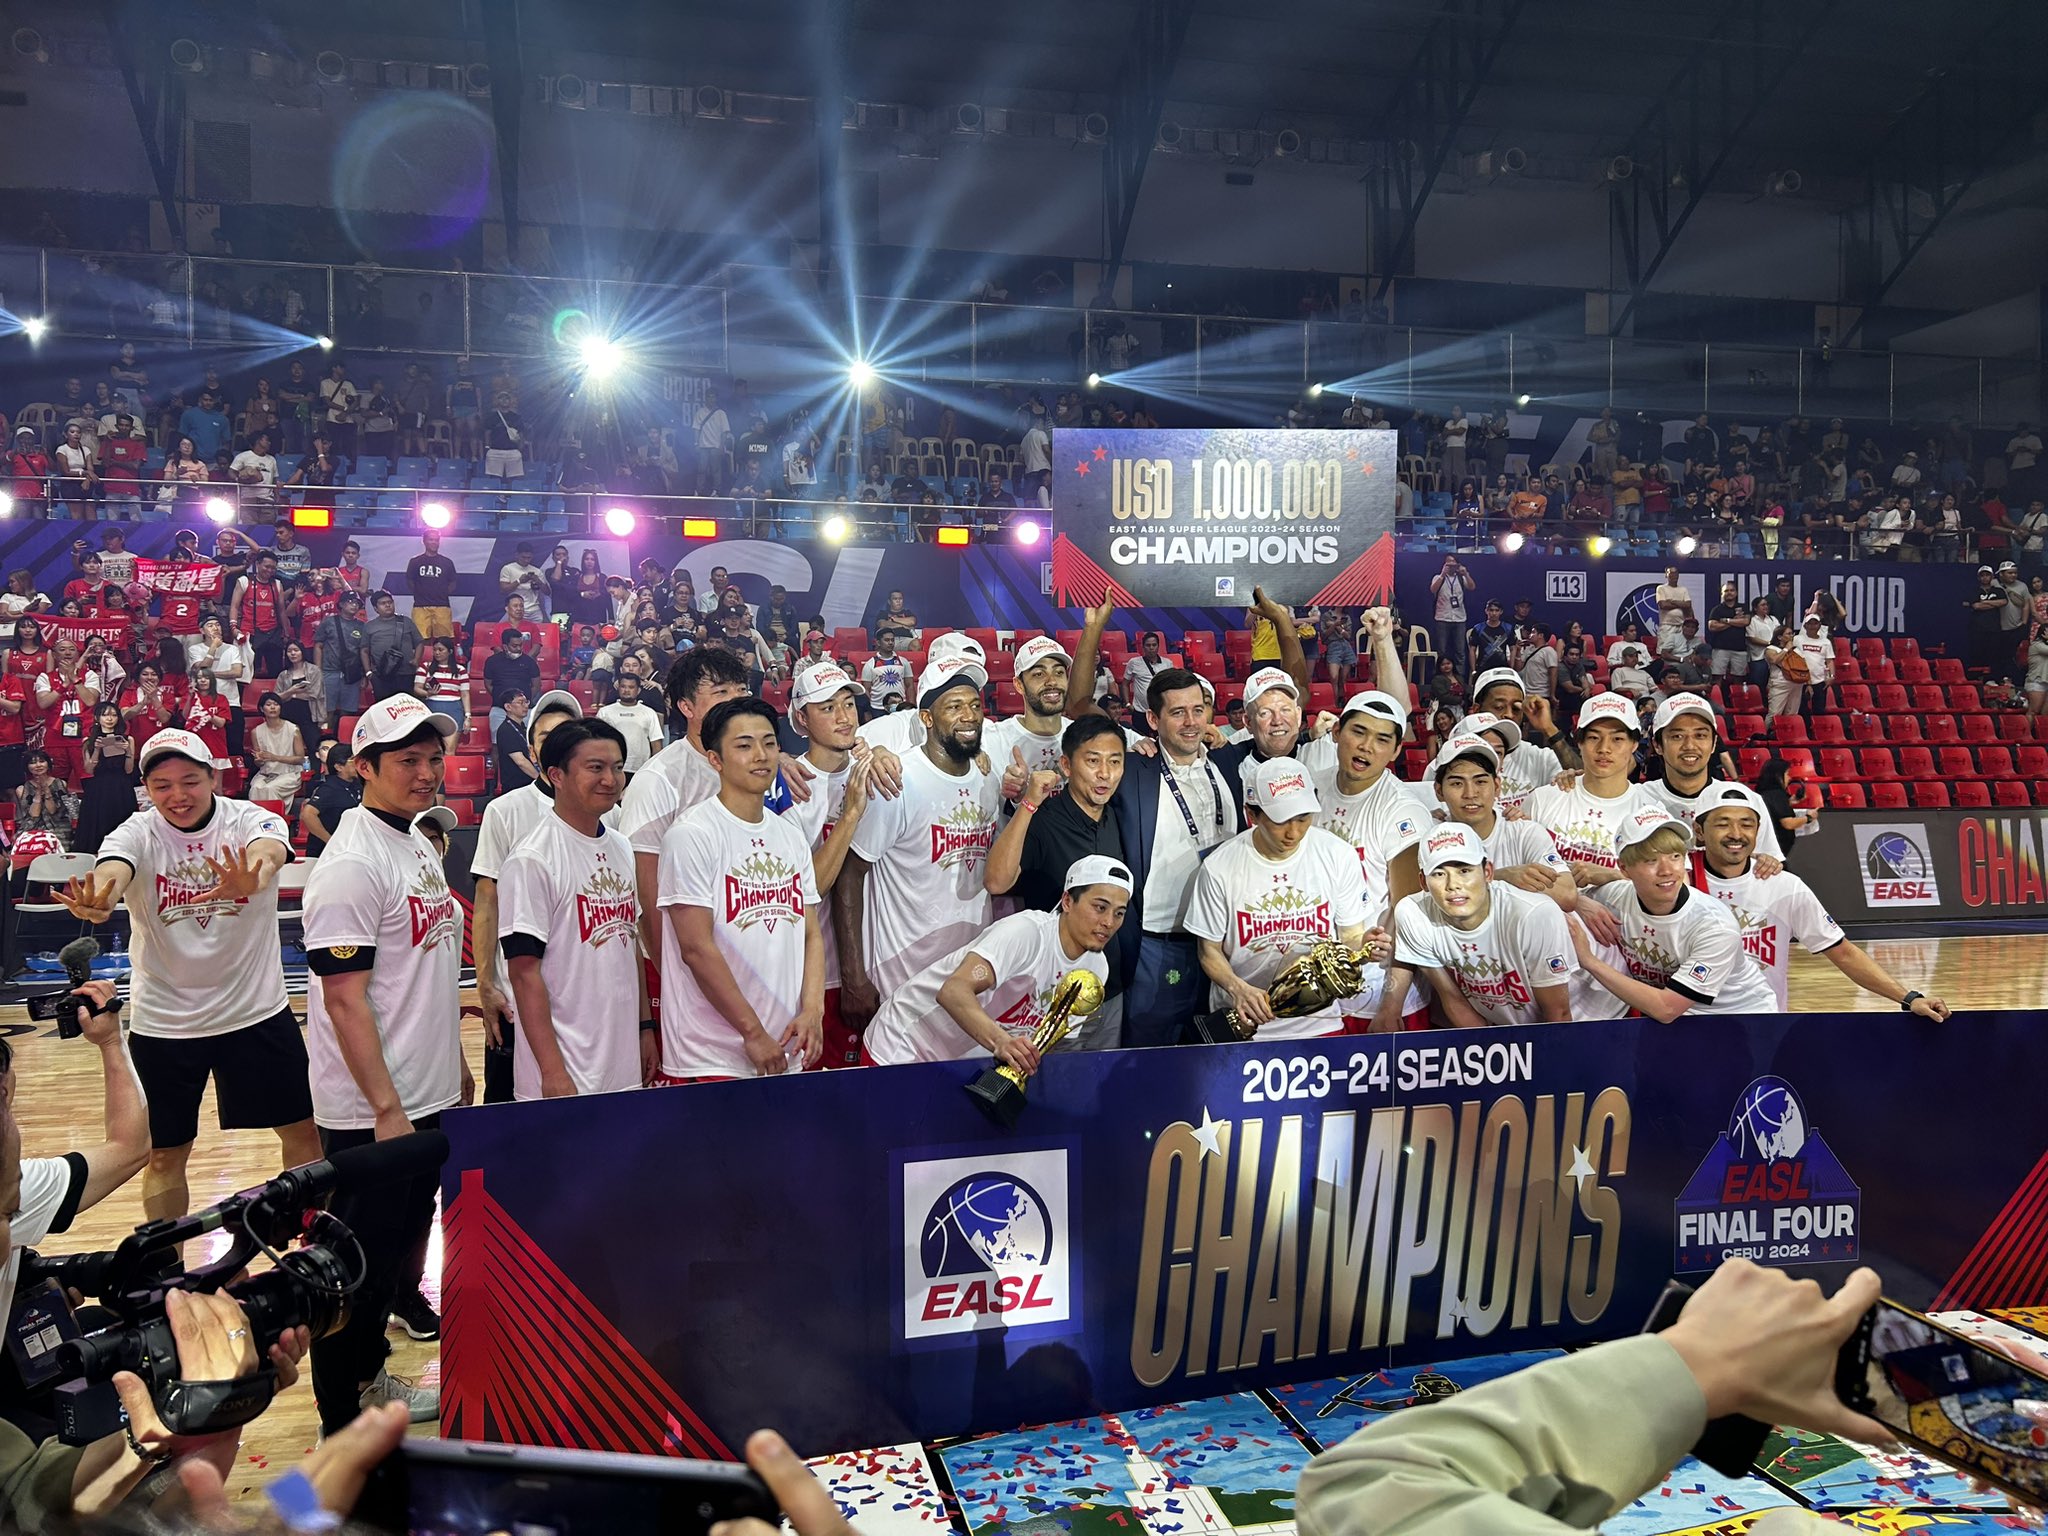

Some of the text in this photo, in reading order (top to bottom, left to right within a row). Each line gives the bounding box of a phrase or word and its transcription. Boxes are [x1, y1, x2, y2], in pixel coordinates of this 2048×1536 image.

[1112, 458, 1343, 522] USD 1,000,000
[1109, 525, 1341, 533] EAST ASIA SUPER LEAGUE 2023-24 SEASON
[1110, 535, 1339, 565] CHAMPIONS
[419, 565, 442, 578] GAP
[1552, 576, 1582, 598] 113
[176, 603, 188, 616] 2
[1268, 774, 1305, 797] CHAMPIONS
[725, 872, 804, 924] CHAMPIONS
[1872, 881, 1932, 900] EASL
[1236, 900, 1331, 948] CHAMPIONS
[1243, 1041, 1533, 1102] 2023-24 SEASON
[1721, 1160, 1811, 1204] EASL
[1130, 1086, 1631, 1388] CHAMPIONS
[1679, 1204, 1855, 1248] FINAL FOUR
[1721, 1243, 1810, 1262] CEBU 2024
[921, 1273, 1054, 1321] EASL
